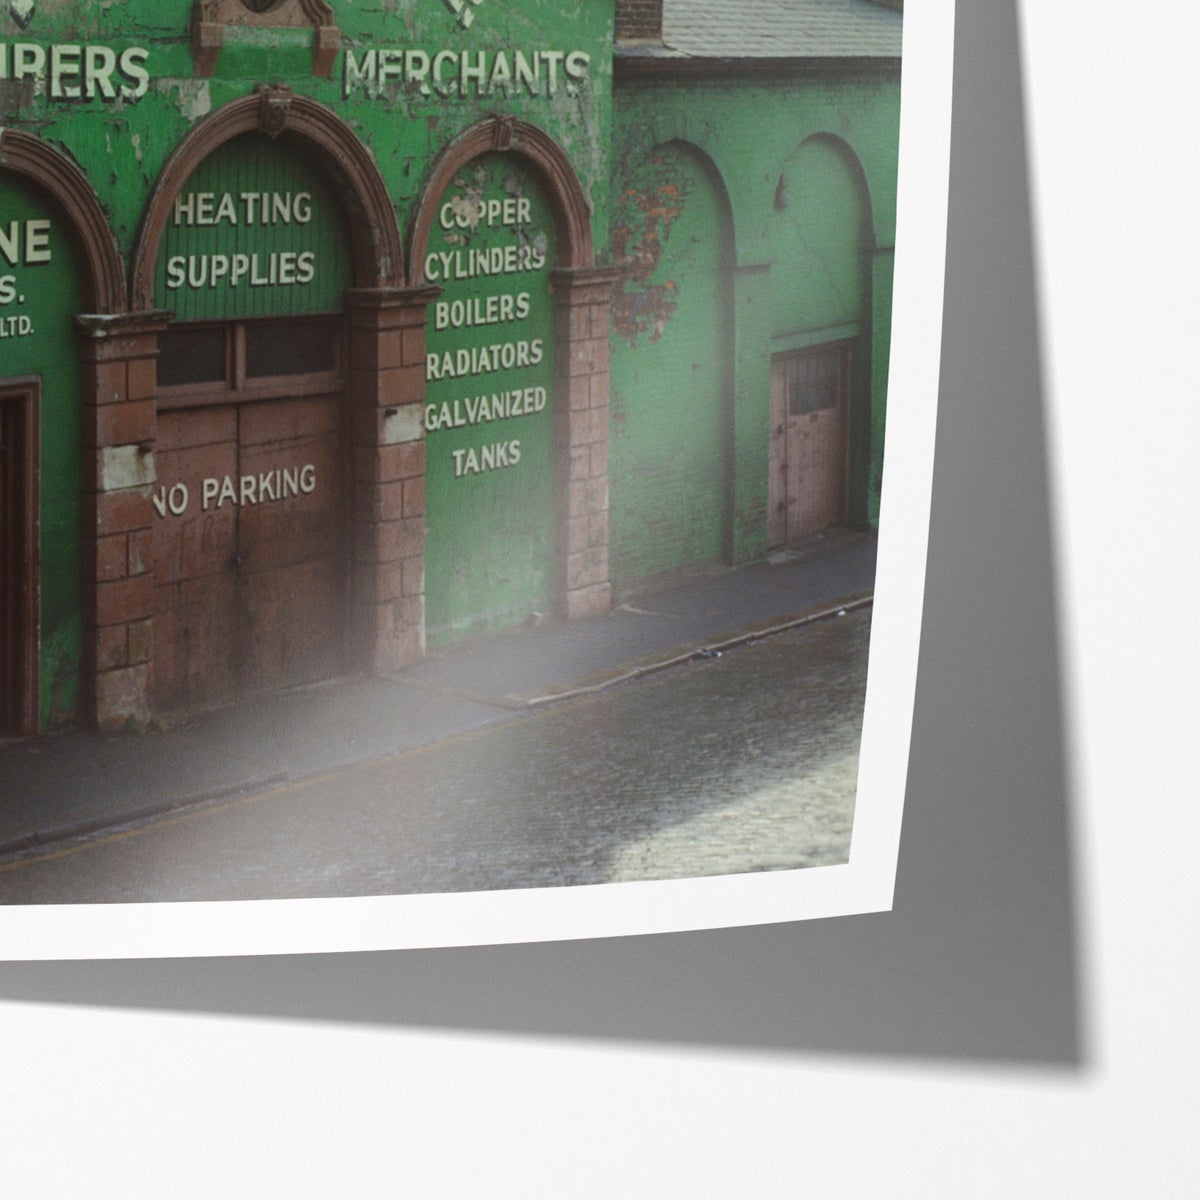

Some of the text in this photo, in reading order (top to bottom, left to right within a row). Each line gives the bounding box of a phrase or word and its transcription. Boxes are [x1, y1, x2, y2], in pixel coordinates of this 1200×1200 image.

[342, 49, 591, 99] MERCHANTS
[174, 192, 312, 226] HEATING
[166, 251, 315, 289] SUPPLIES
[424, 245, 546, 282] CYLINDERS
[0, 315, 34, 338] LTD.
[435, 292, 531, 331] BOILERS
[425, 339, 544, 381] RADIATORS
[423, 386, 547, 433] GALVANIZED
[452, 439, 522, 478] TANKS
[152, 464, 317, 519] NO PARKING
